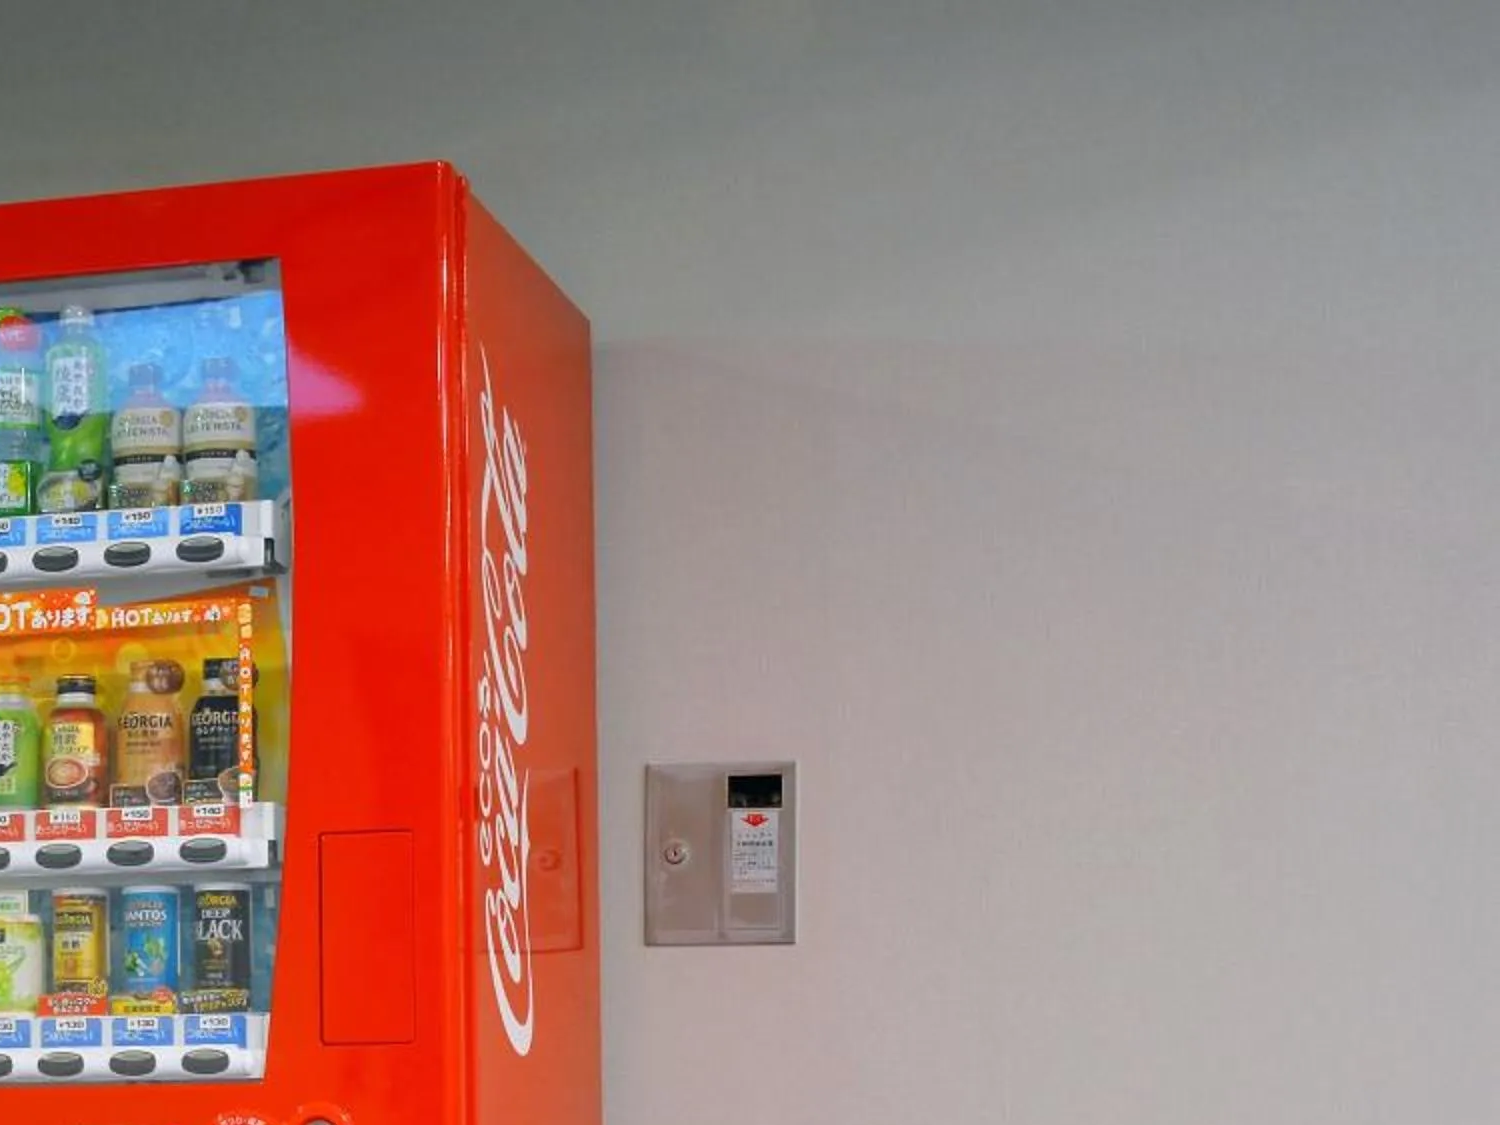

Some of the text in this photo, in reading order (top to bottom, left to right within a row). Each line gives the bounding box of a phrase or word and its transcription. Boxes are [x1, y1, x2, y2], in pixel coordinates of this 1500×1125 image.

[480, 339, 533, 1056] Coca-Cola
[193, 708, 239, 725] EORGI
[197, 919, 243, 941] LACK
